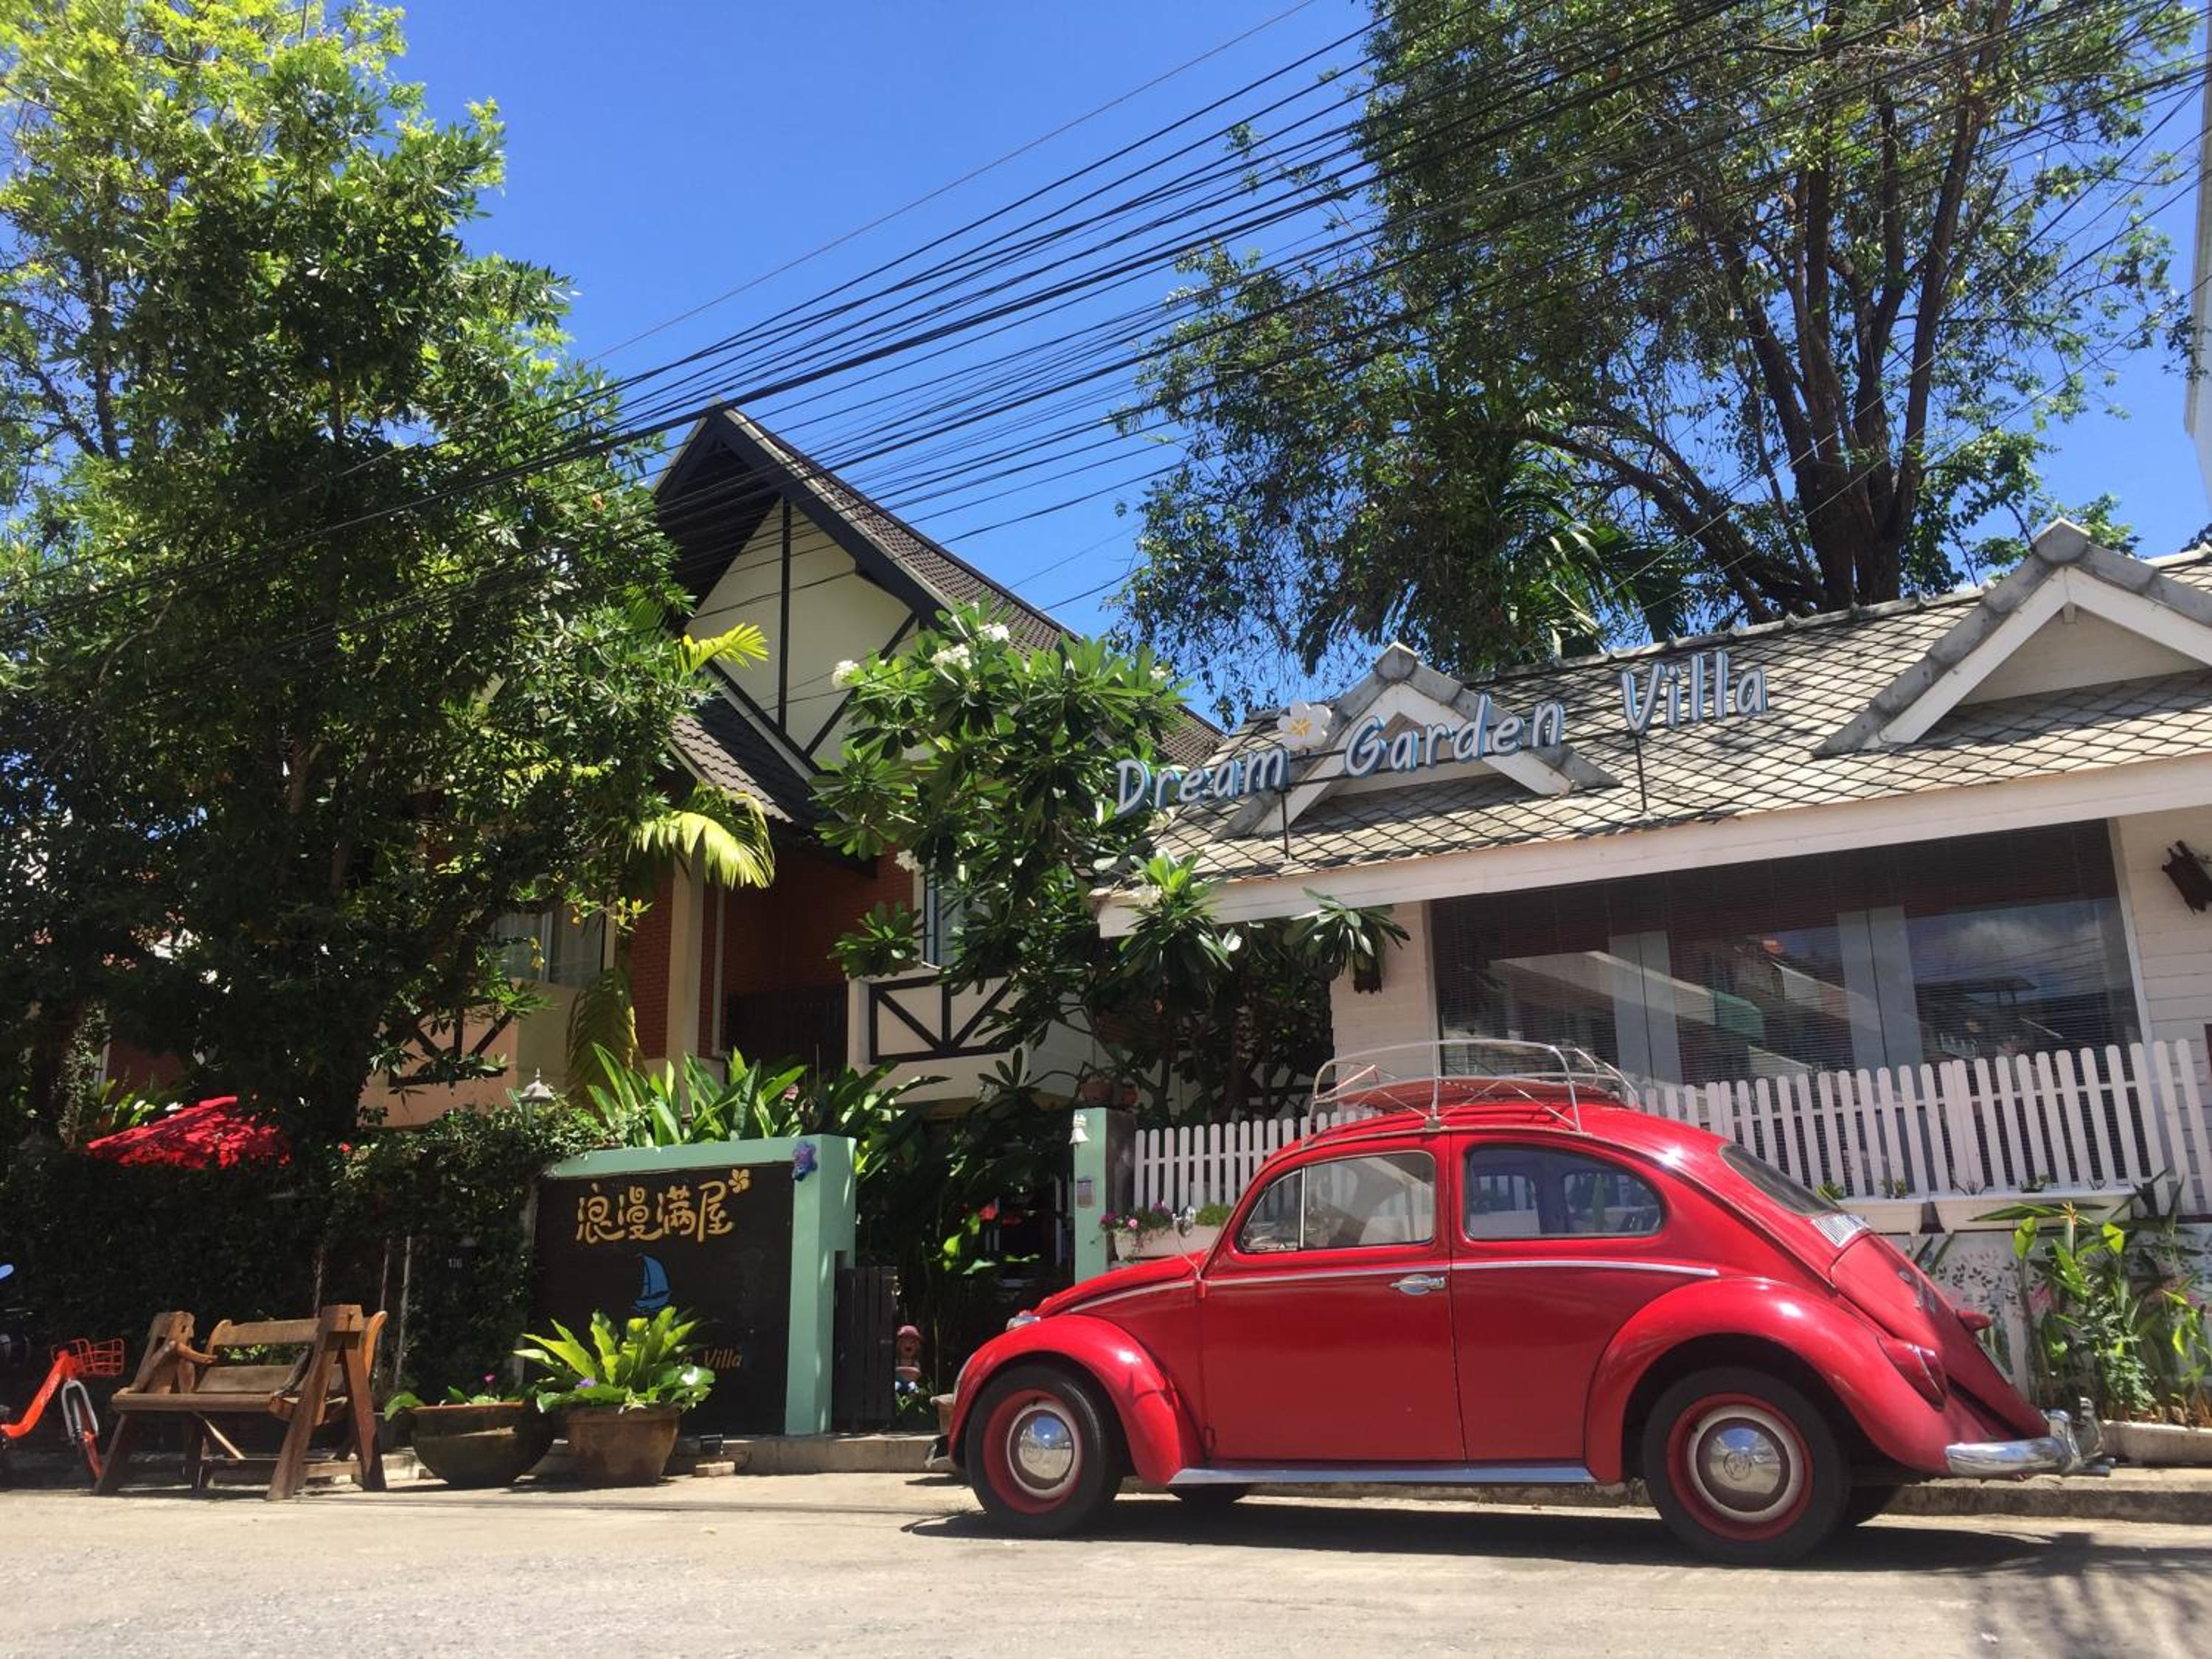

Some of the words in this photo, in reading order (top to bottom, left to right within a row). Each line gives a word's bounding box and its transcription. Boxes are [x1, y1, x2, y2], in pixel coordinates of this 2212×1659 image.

[1115, 745, 1291, 816] Dream
[1344, 693, 1564, 778] Garden
[1621, 648, 1768, 734] Villa
[575, 1180, 734, 1244] 浪漫满屋
[703, 1346, 744, 1368] Villa
